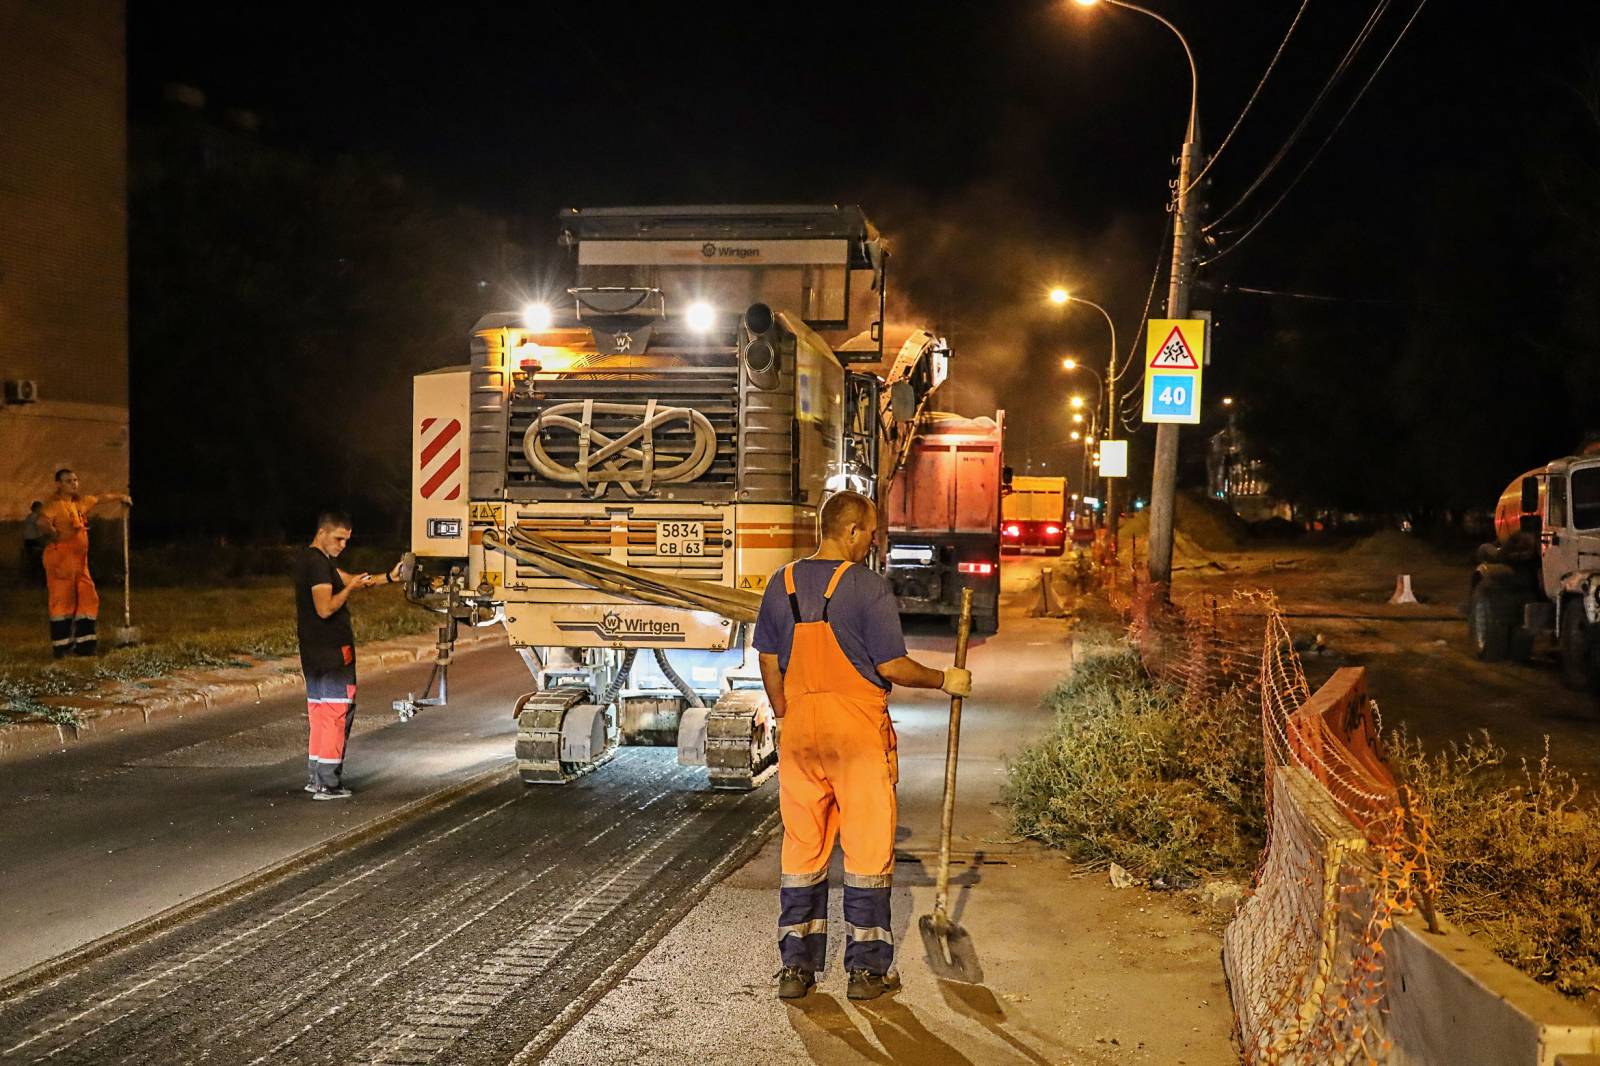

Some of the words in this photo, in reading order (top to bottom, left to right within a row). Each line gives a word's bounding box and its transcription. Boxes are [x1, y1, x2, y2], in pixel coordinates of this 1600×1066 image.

[718, 247, 759, 258] Wirtgen
[1158, 386, 1186, 405] 40
[662, 523, 699, 538] 5834
[685, 542, 700, 554] 63
[624, 619, 680, 635] Wirtgen
